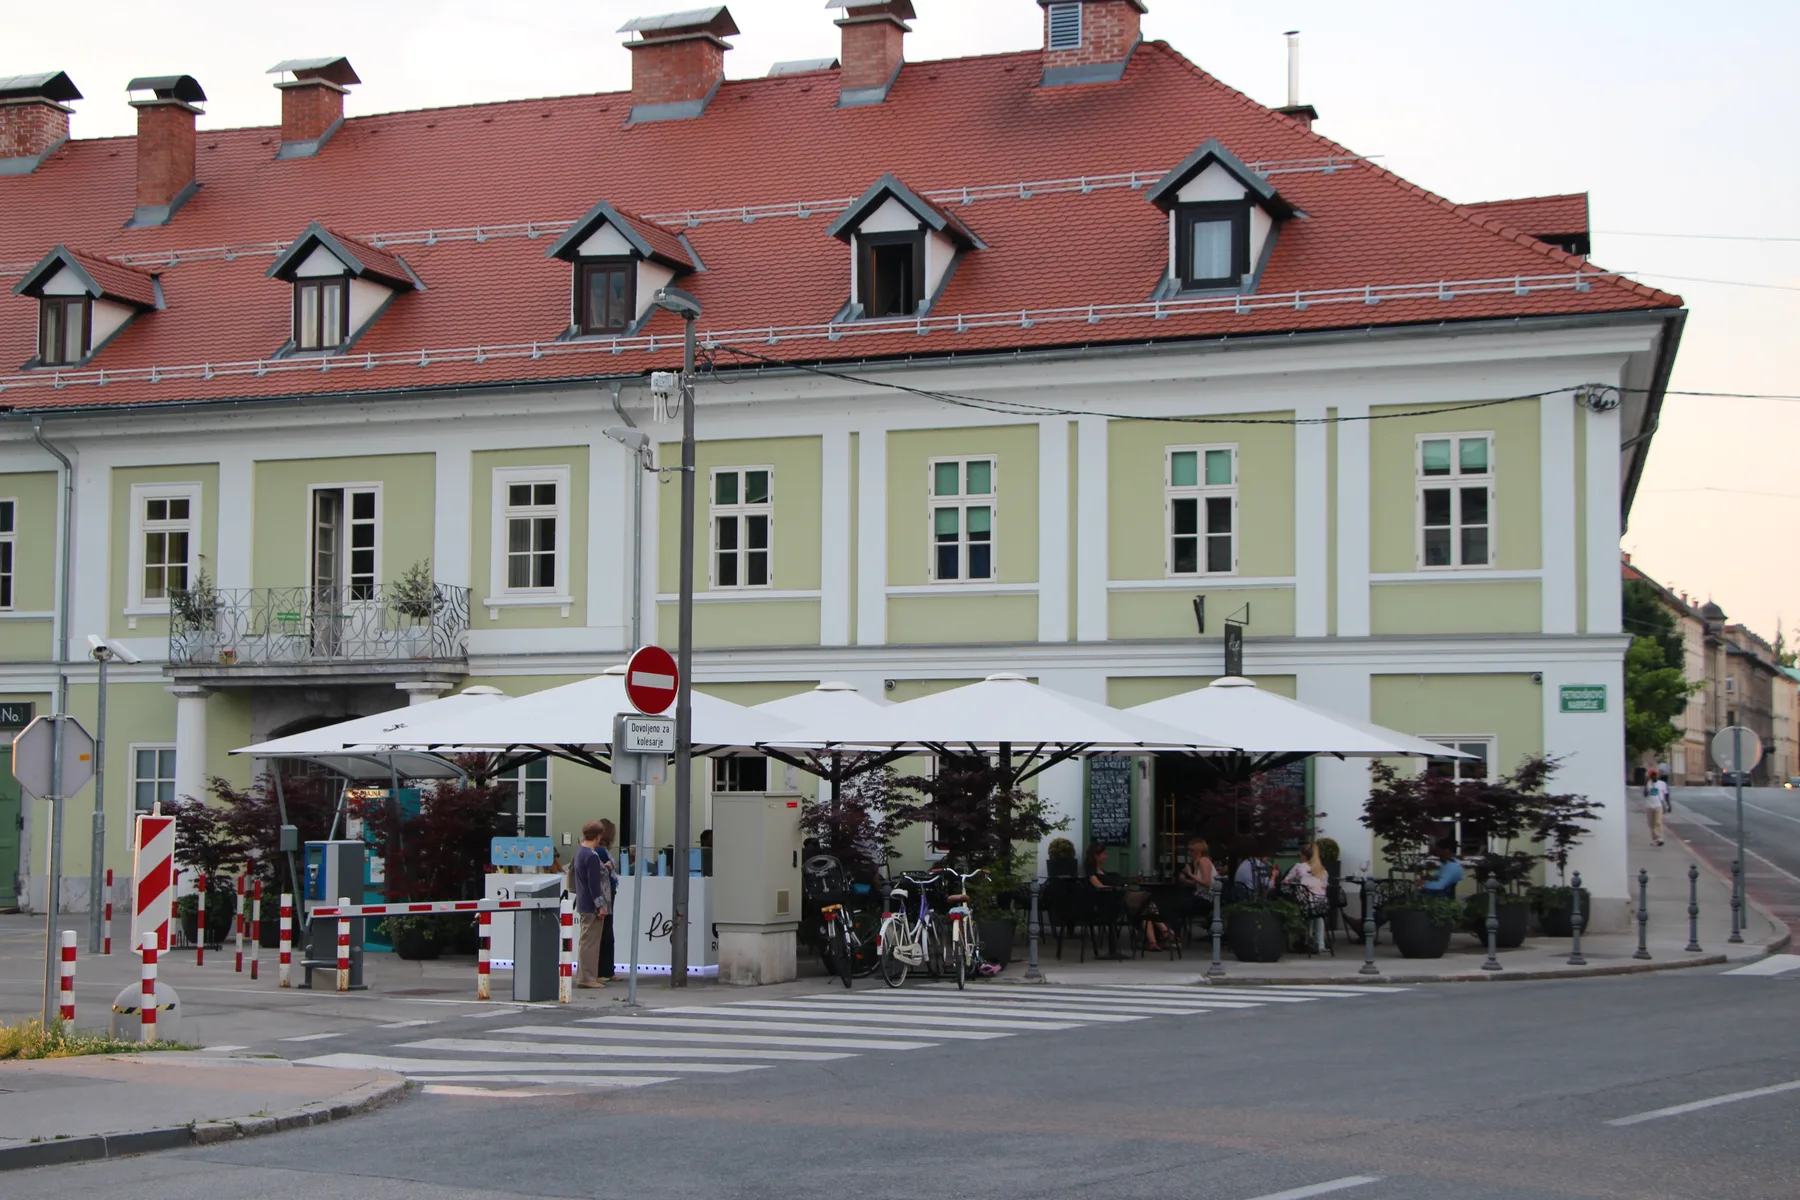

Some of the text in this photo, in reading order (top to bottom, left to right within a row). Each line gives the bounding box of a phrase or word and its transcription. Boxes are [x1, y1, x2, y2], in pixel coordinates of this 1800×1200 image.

[631, 722, 670, 734] Dovoljeno za
[636, 736, 664, 748] kolesarje
